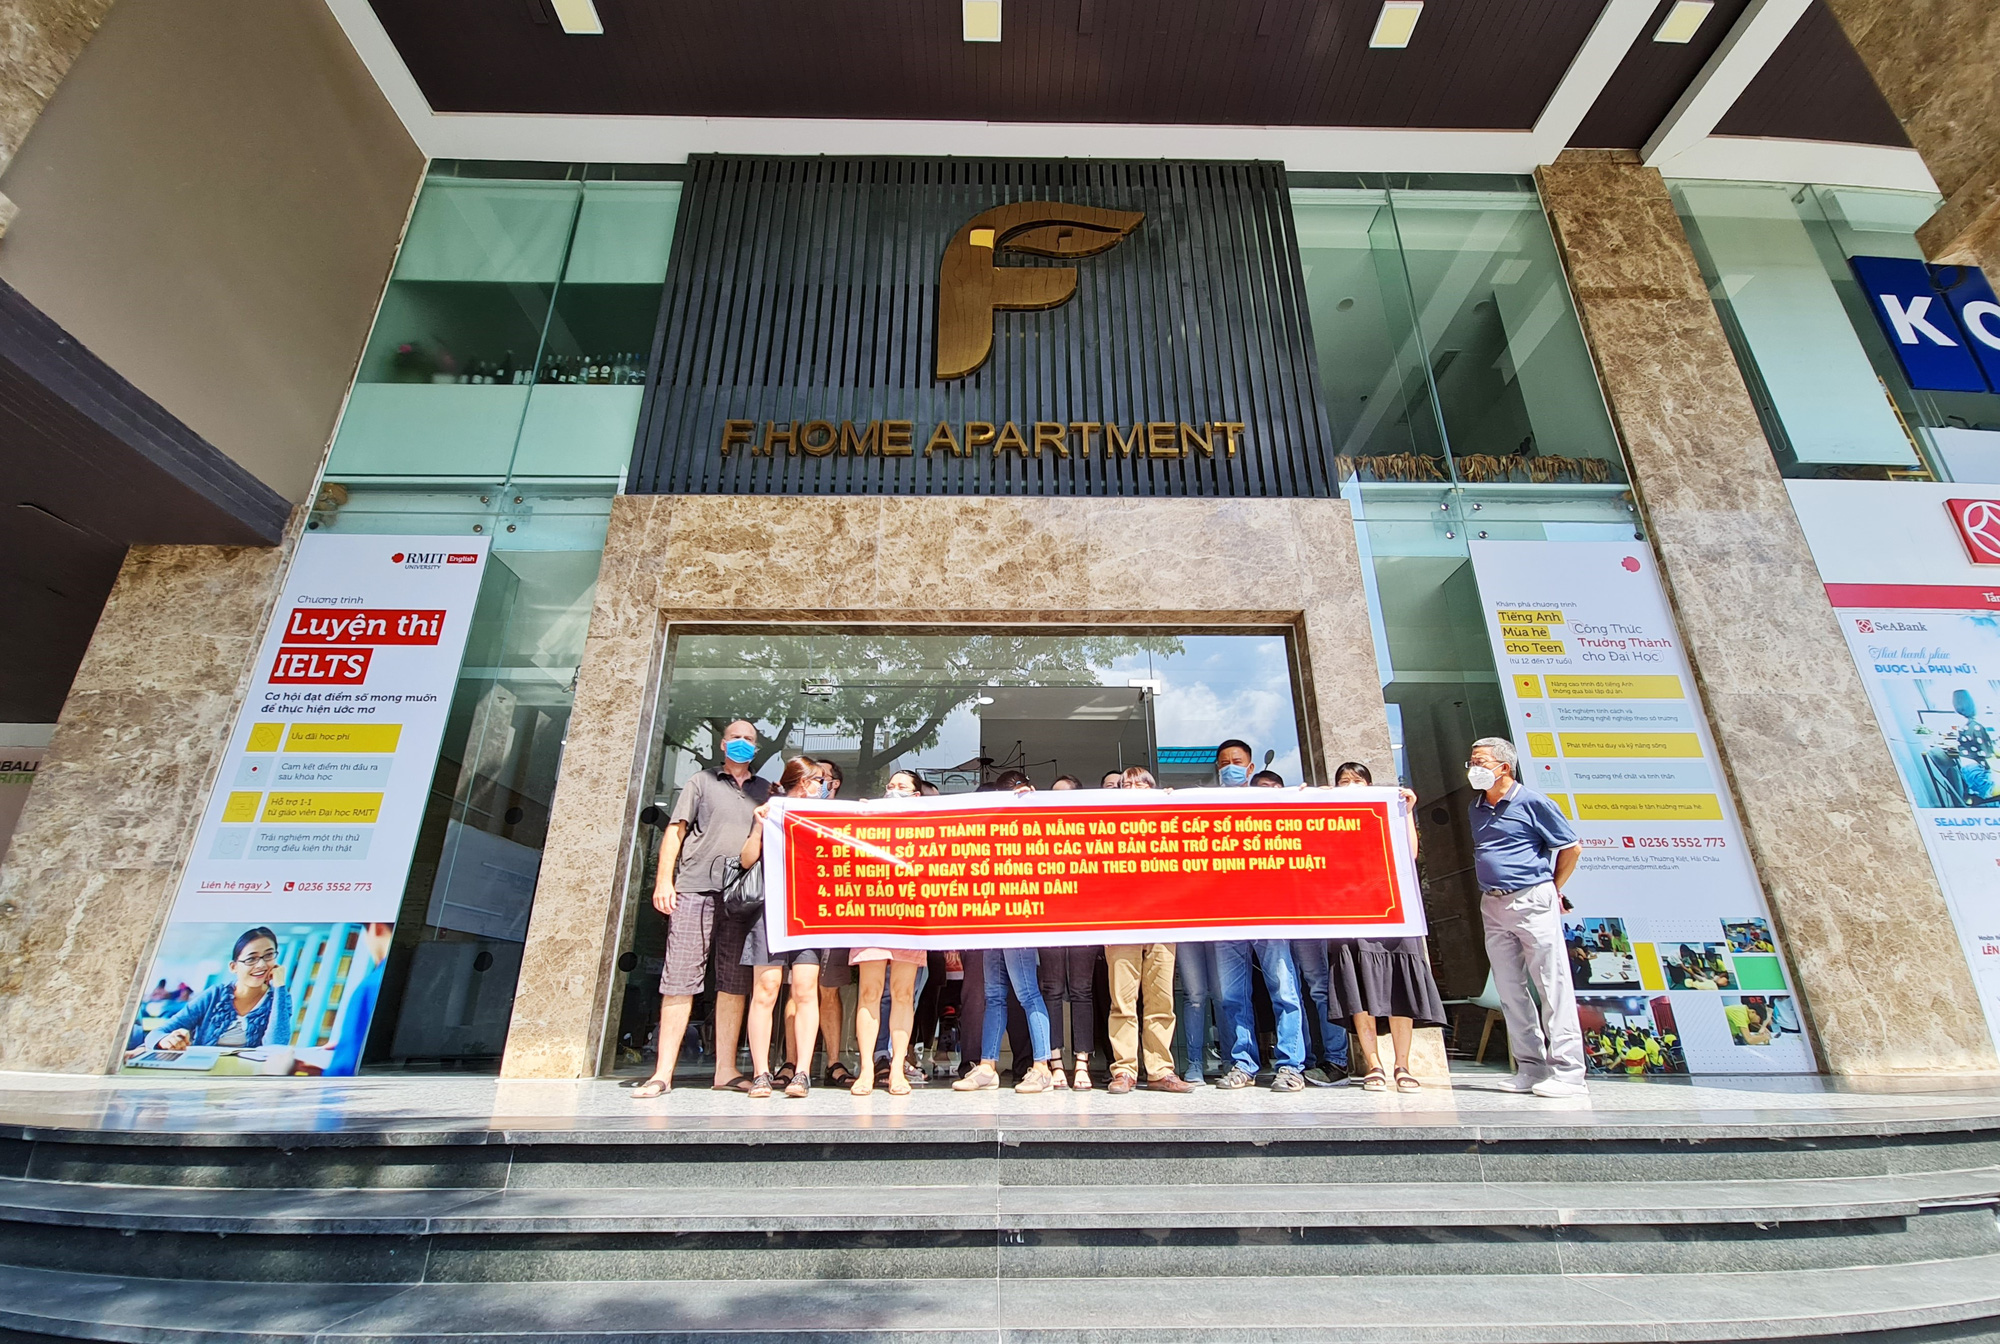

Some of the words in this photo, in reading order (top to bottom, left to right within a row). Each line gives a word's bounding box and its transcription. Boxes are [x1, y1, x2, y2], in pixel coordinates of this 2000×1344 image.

[721, 419, 912, 456] F.HOME
[925, 421, 1244, 459] APARTMENT
[406, 553, 446, 563] RMIT
[297, 595, 339, 606] Chương
[340, 595, 364, 604] trình
[1498, 611, 1533, 624] Tiếng
[1536, 612, 1561, 622] Anh
[290, 613, 386, 641] Luyện
[397, 614, 438, 636] thi
[1502, 627, 1530, 637] Mùa
[1530, 627, 1547, 637] hè
[1575, 624, 1608, 635] Công
[1610, 624, 1643, 634] Thức
[1875, 622, 1927, 631] SeABank
[1506, 643, 1530, 652] cho
[1532, 643, 1562, 652] Teen
[1578, 637, 1625, 649] Trưởng
[1628, 638, 1672, 648] Thành
[1582, 651, 1606, 661] cho
[1608, 651, 1630, 662] Đại
[1632, 651, 1659, 662] Học
[273, 654, 365, 678] IELTS
[264, 691, 281, 703] Cơ
[282, 692, 302, 702] hội
[303, 692, 322, 703] đạt
[324, 691, 352, 702] điểm
[354, 693, 369, 702] số
[370, 695, 403, 704] mong
[405, 693, 437, 702] muốn
[260, 703, 277, 713] để
[277, 704, 304, 714] thực
[305, 704, 331, 714] hiện
[333, 705, 355, 714] ước
[357, 706, 376, 714] mơ
[0, 761, 39, 771] BALI
[1934, 817, 1981, 826] SEALADY
[856, 827, 890, 842] NGHỊ
[895, 826, 935, 840] UBND
[938, 822, 986, 838] THÀNH
[990, 819, 1019, 837] PHỐ
[1022, 820, 1042, 836] ĐÀ
[1045, 818, 1085, 836] NẴNG
[1088, 819, 1116, 835] VÀO
[1120, 818, 1157, 837] CUỘC
[1160, 815, 1179, 834] ĐỂ
[1182, 815, 1210, 833] CẤP
[1213, 815, 1232, 832] SỔ
[1276, 819, 1302, 832] CHO
[1306, 817, 1326, 832] CƯ
[1327, 816, 1361, 832] DÂN!
[816, 845, 828, 858] 2.
[895, 842, 915, 858] SỞ
[918, 842, 947, 858] XÂY
[951, 842, 991, 859] DỰNG
[994, 842, 1022, 856] THU
[1053, 839, 1082, 856] CÁC
[1085, 838, 1114, 855] VĂN
[1117, 836, 1147, 854] BẢN
[1150, 836, 1179, 853] CẢN
[1182, 835, 1209, 853] TRỞ
[1211, 835, 1239, 852] CẤP
[1242, 834, 1261, 852] SỔ
[1638, 837, 1670, 848] 0236
[1670, 837, 1703, 848] 3552
[1703, 837, 1726, 848] 773
[817, 865, 830, 877] 3.
[855, 864, 890, 880] NGHỊ
[928, 863, 968, 876] NGAY
[970, 857, 990, 876] SỔ
[1037, 861, 1066, 875] CHO
[1069, 858, 1099, 874] DÂN
[1102, 859, 1137, 874] THEO
[1140, 857, 1179, 873] ĐÚNG
[1182, 858, 1209, 873] QUY
[1212, 857, 1246, 874] ĐỊNH
[1248, 854, 1285, 870] PHÁP
[1288, 854, 1326, 872] LUẬT!
[297, 882, 324, 892] 0236
[325, 882, 352, 892] 3552
[353, 882, 373, 892] 773
[817, 884, 831, 898] 4.
[834, 881, 862, 897] HÃY
[866, 880, 894, 898] BẢO
[898, 881, 916, 900] VỆ
[973, 881, 995, 899] LỢI
[999, 879, 1040, 896] NHÂN
[1043, 878, 1078, 895] DÂN!
[818, 904, 832, 917] 5.
[868, 902, 925, 920] THƯỢNG
[928, 901, 958, 918] TÔN
[962, 900, 1001, 917] PHÁP
[1005, 899, 1045, 918] LUẬT!
